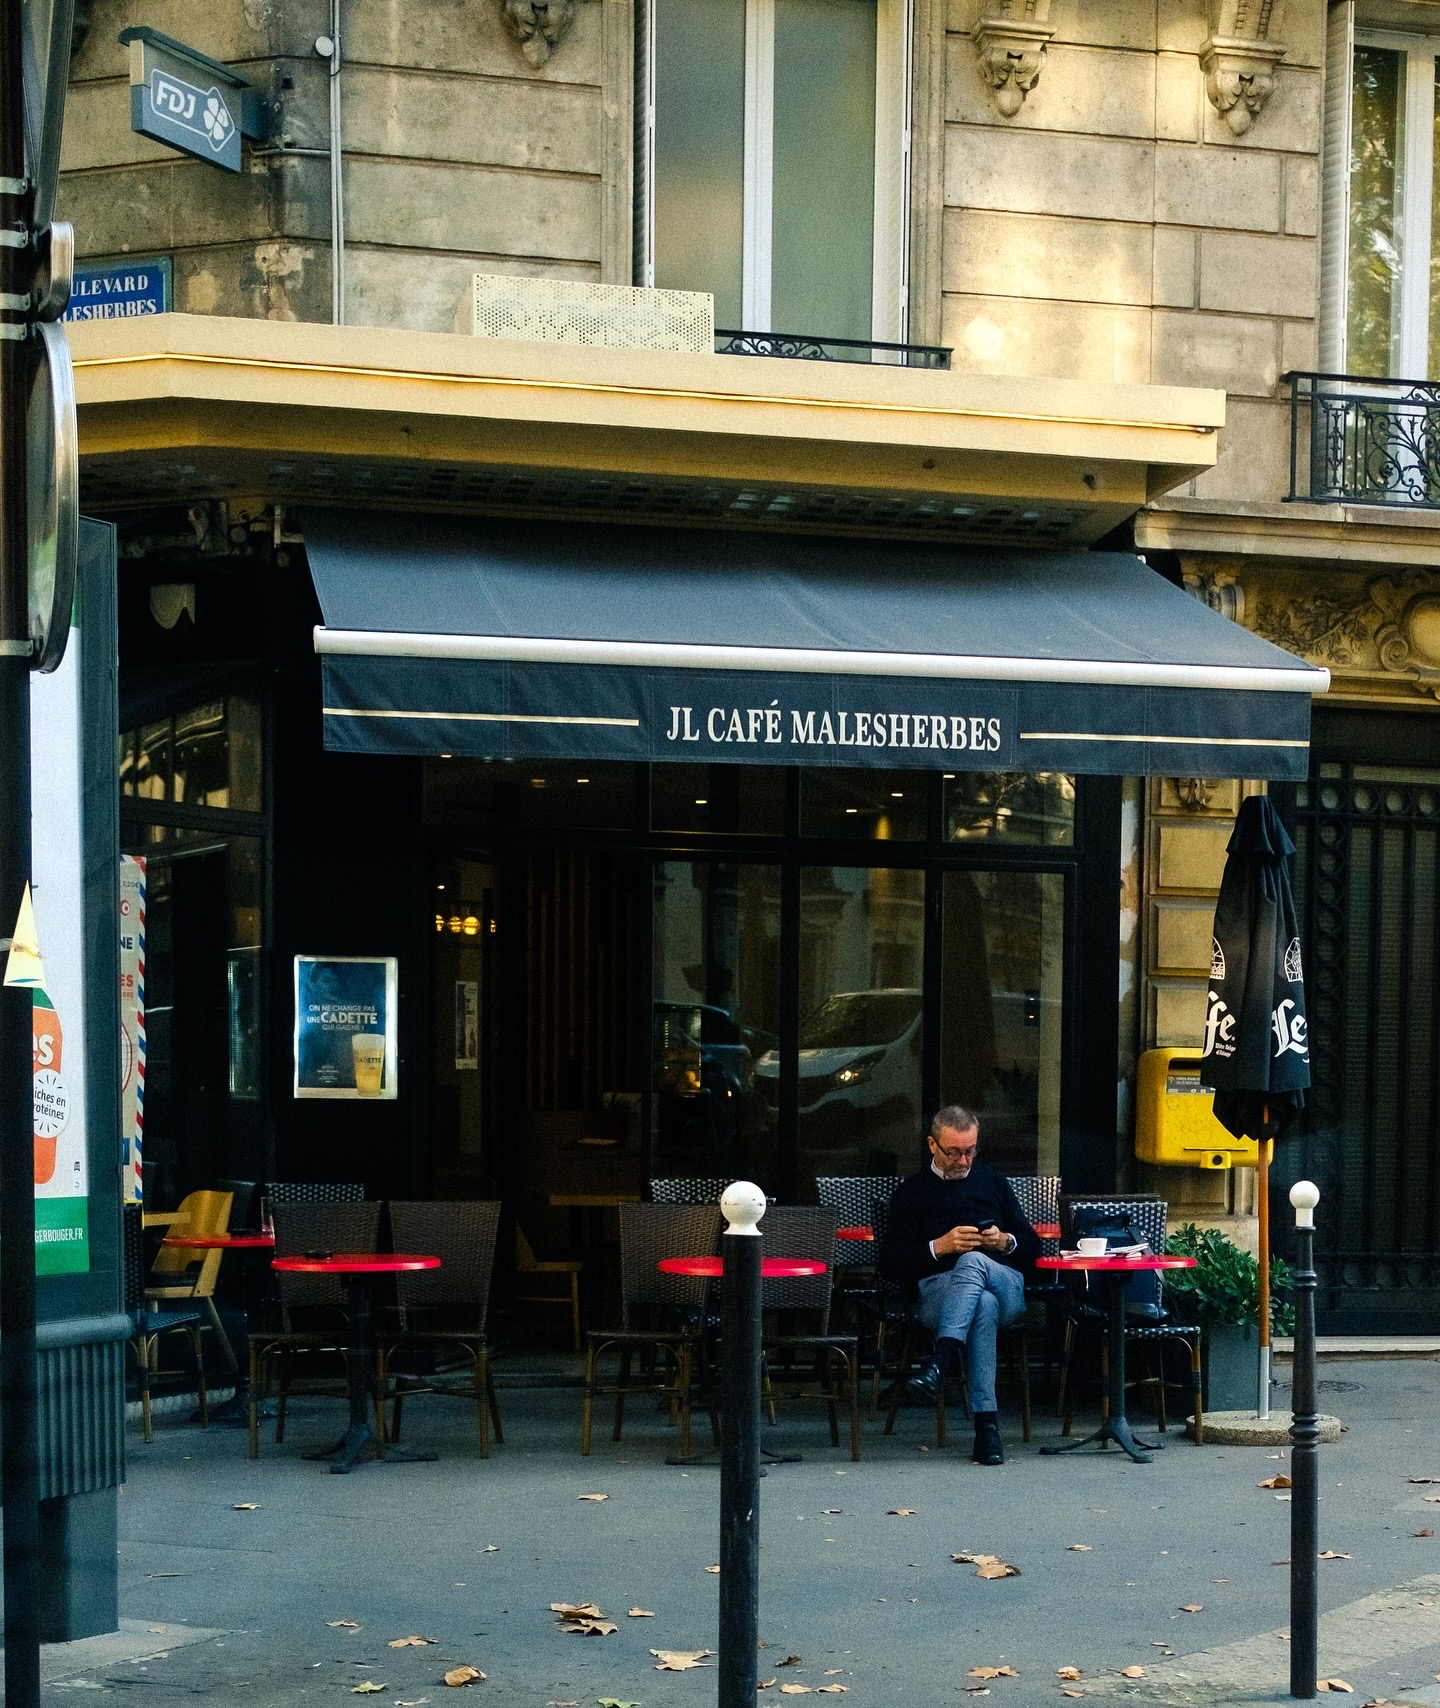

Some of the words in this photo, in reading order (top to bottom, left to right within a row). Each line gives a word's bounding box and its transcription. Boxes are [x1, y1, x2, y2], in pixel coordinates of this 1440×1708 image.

[156, 80, 197, 119] FDJ
[57, 299, 157, 323] LESHERBES
[667, 707, 699, 741] JL
[708, 699, 782, 743] CAFÉ
[791, 711, 1001, 752] MALESHERBES
[307, 1016, 320, 1024] UNE
[321, 1012, 377, 1024] CADETTE
[56, 1096, 66, 1107] en
[35, 1227, 84, 1243] GERBOUGER.FR
